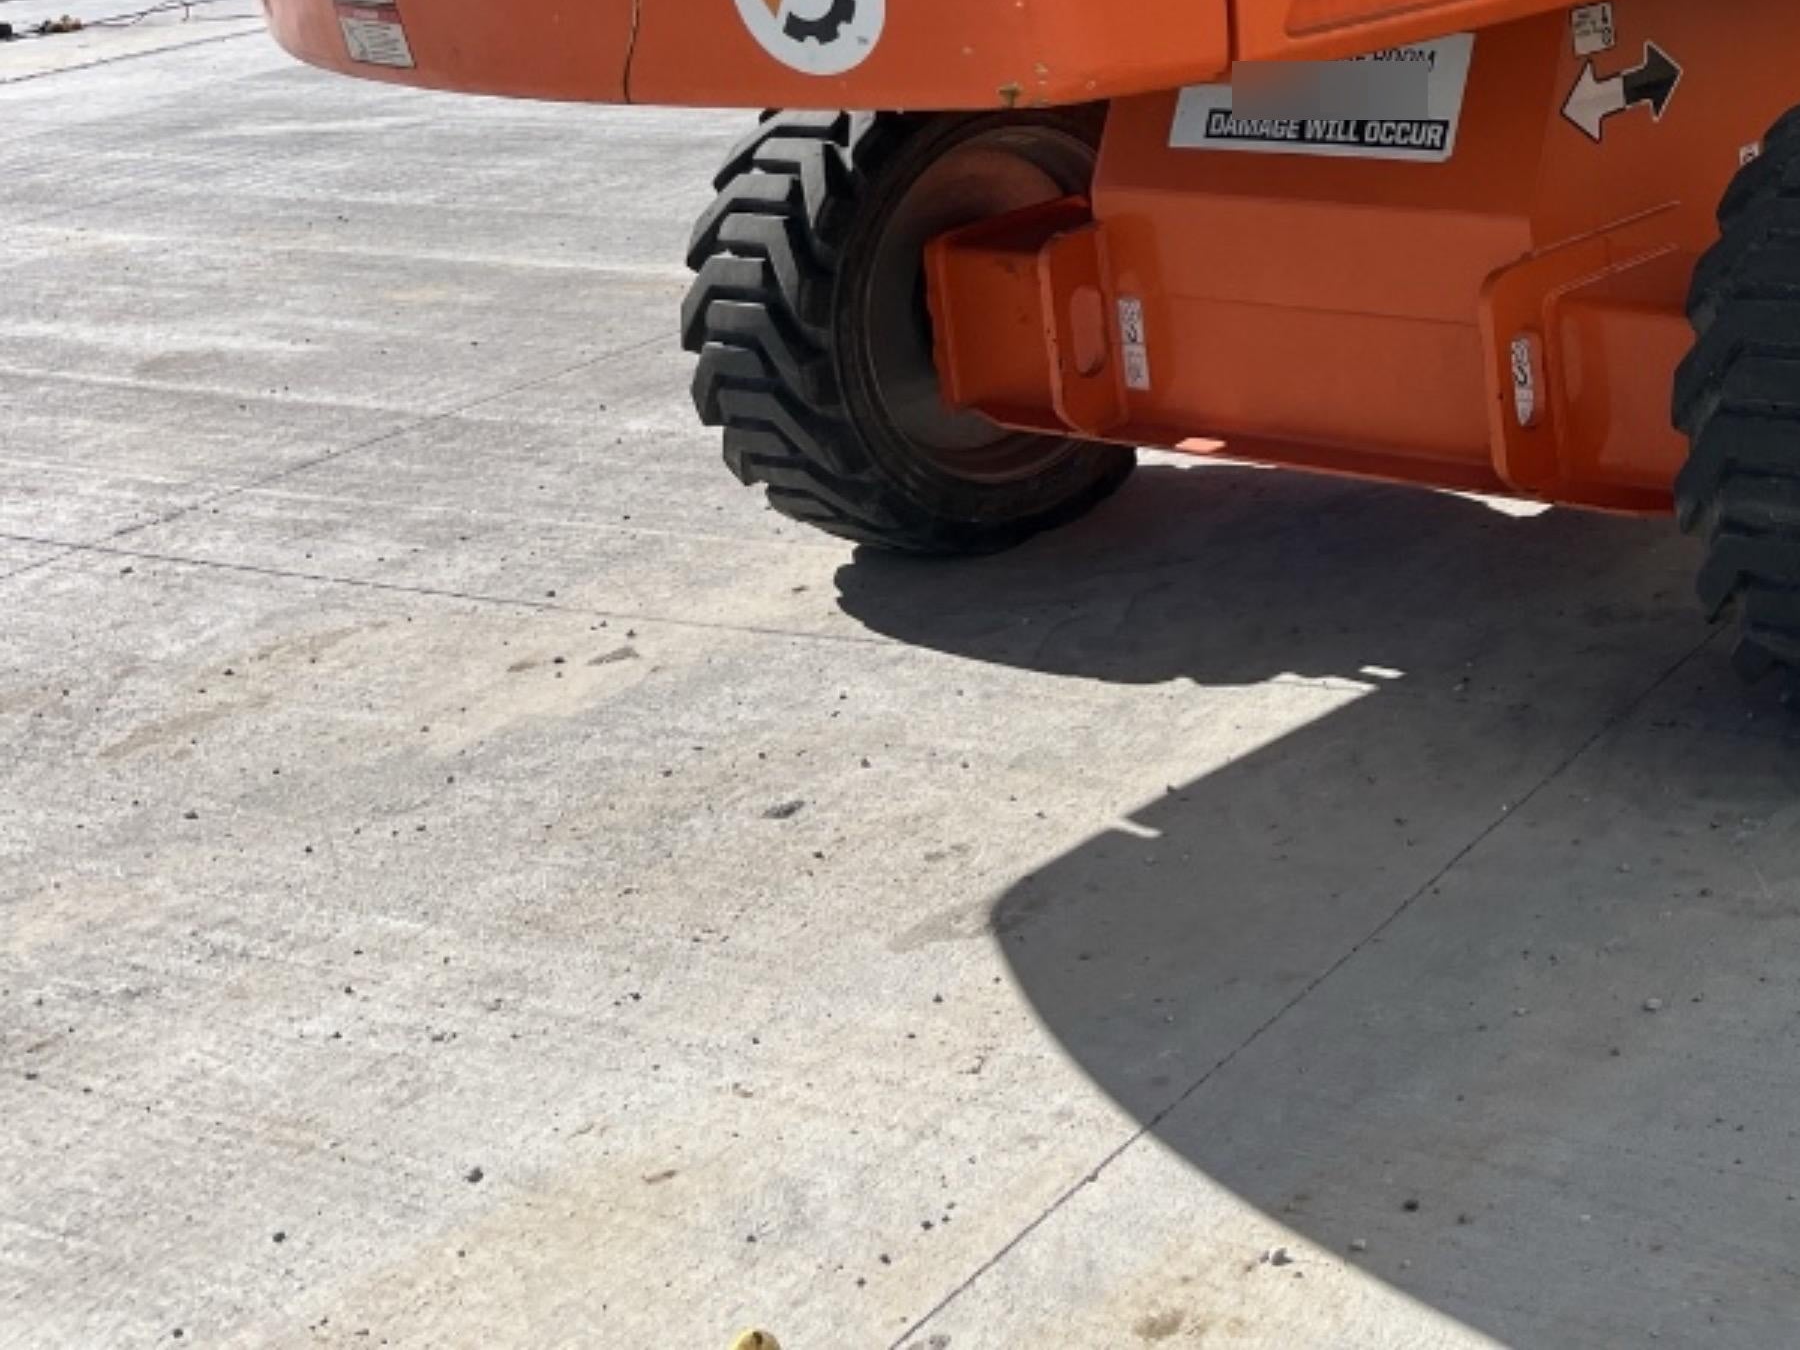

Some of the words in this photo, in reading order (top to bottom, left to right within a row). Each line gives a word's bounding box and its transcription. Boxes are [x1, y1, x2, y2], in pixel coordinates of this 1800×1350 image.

[1208, 112, 1300, 141] DAMAGE
[1304, 119, 1360, 143] WILL
[1364, 121, 1444, 149] OCCUR
